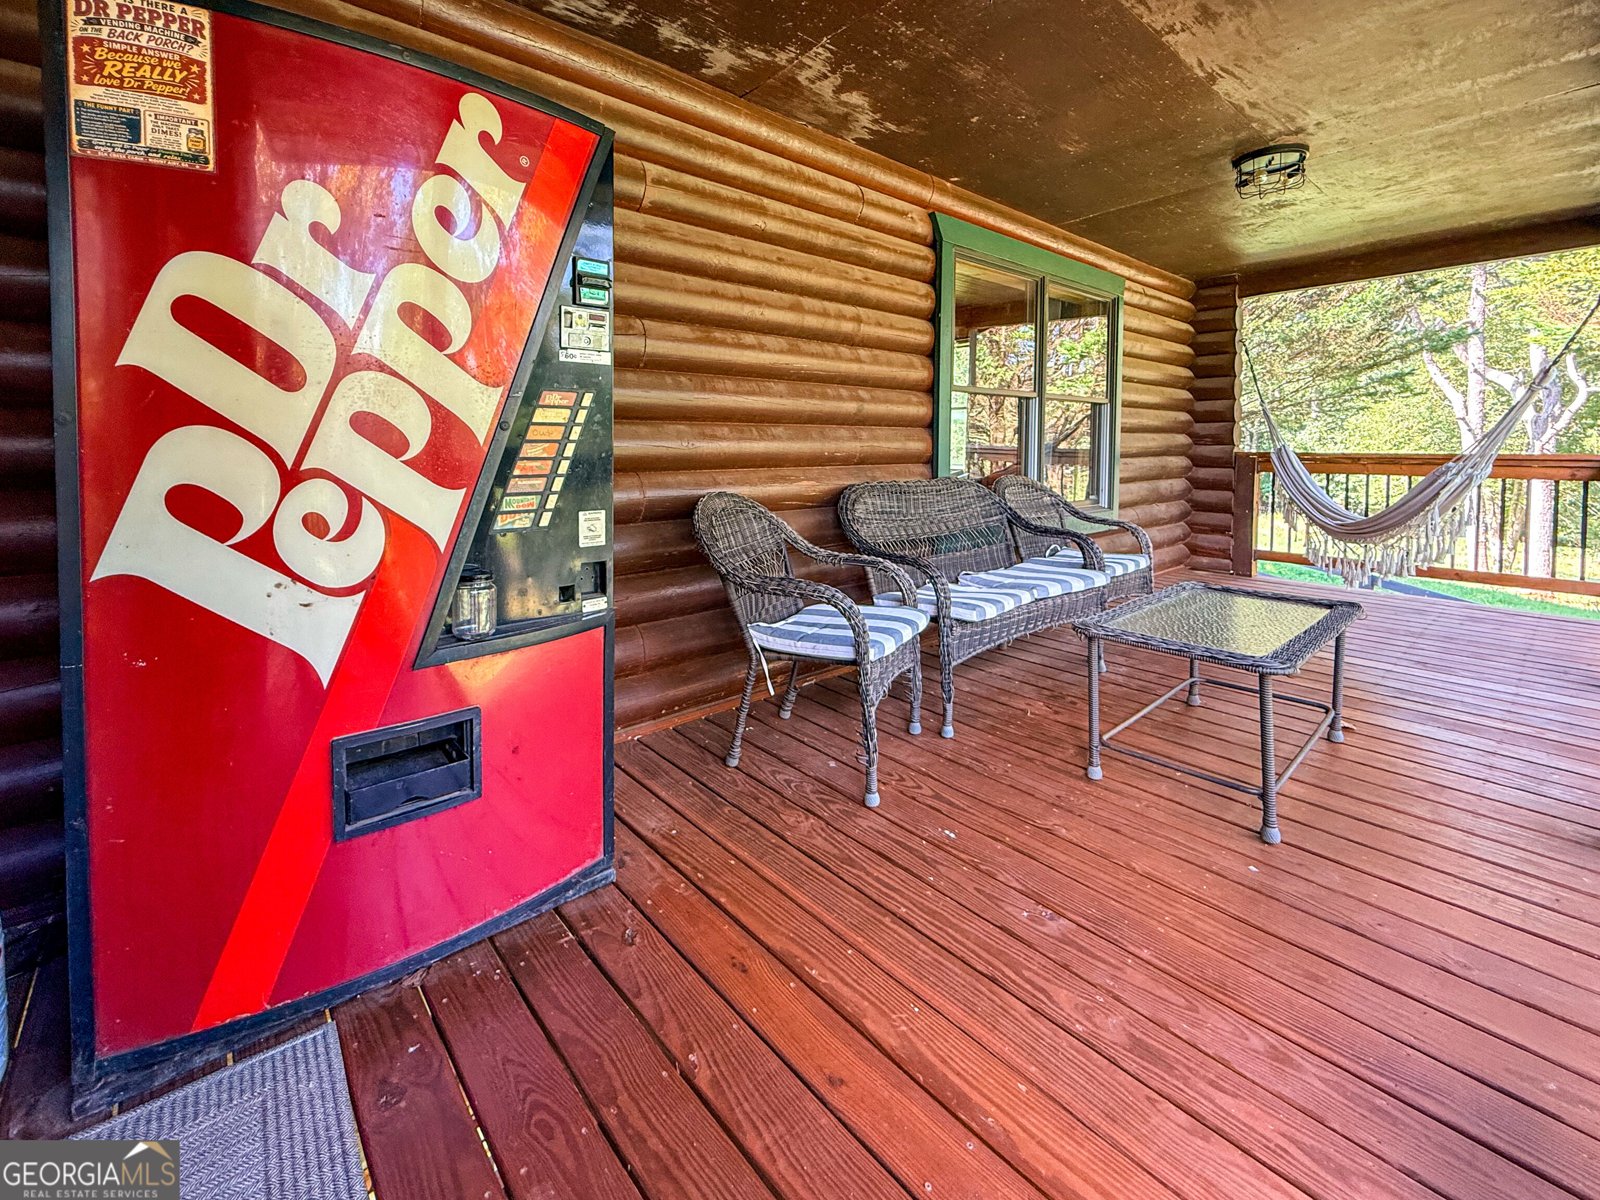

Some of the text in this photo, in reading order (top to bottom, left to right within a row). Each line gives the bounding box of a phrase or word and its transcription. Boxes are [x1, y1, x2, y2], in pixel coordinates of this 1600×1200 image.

[141, 0, 188, 15] THERE A
[73, 0, 206, 40] DR PEPPER
[100, 19, 185, 40] VENDING MACHINE
[102, 41, 180, 60] SIMPLE ANSWER
[107, 28, 143, 43] BACK
[146, 35, 194, 54] PORCH?
[94, 47, 182, 69] Because we
[102, 61, 188, 82] REALLY
[123, 77, 141, 88] Dr
[143, 79, 190, 96] Pepper!
[156, 114, 195, 125] IMPORTANT
[151, 128, 182, 137] DIMES!
[115, 178, 377, 471] Dr
[90, 92, 527, 690] Pepper
